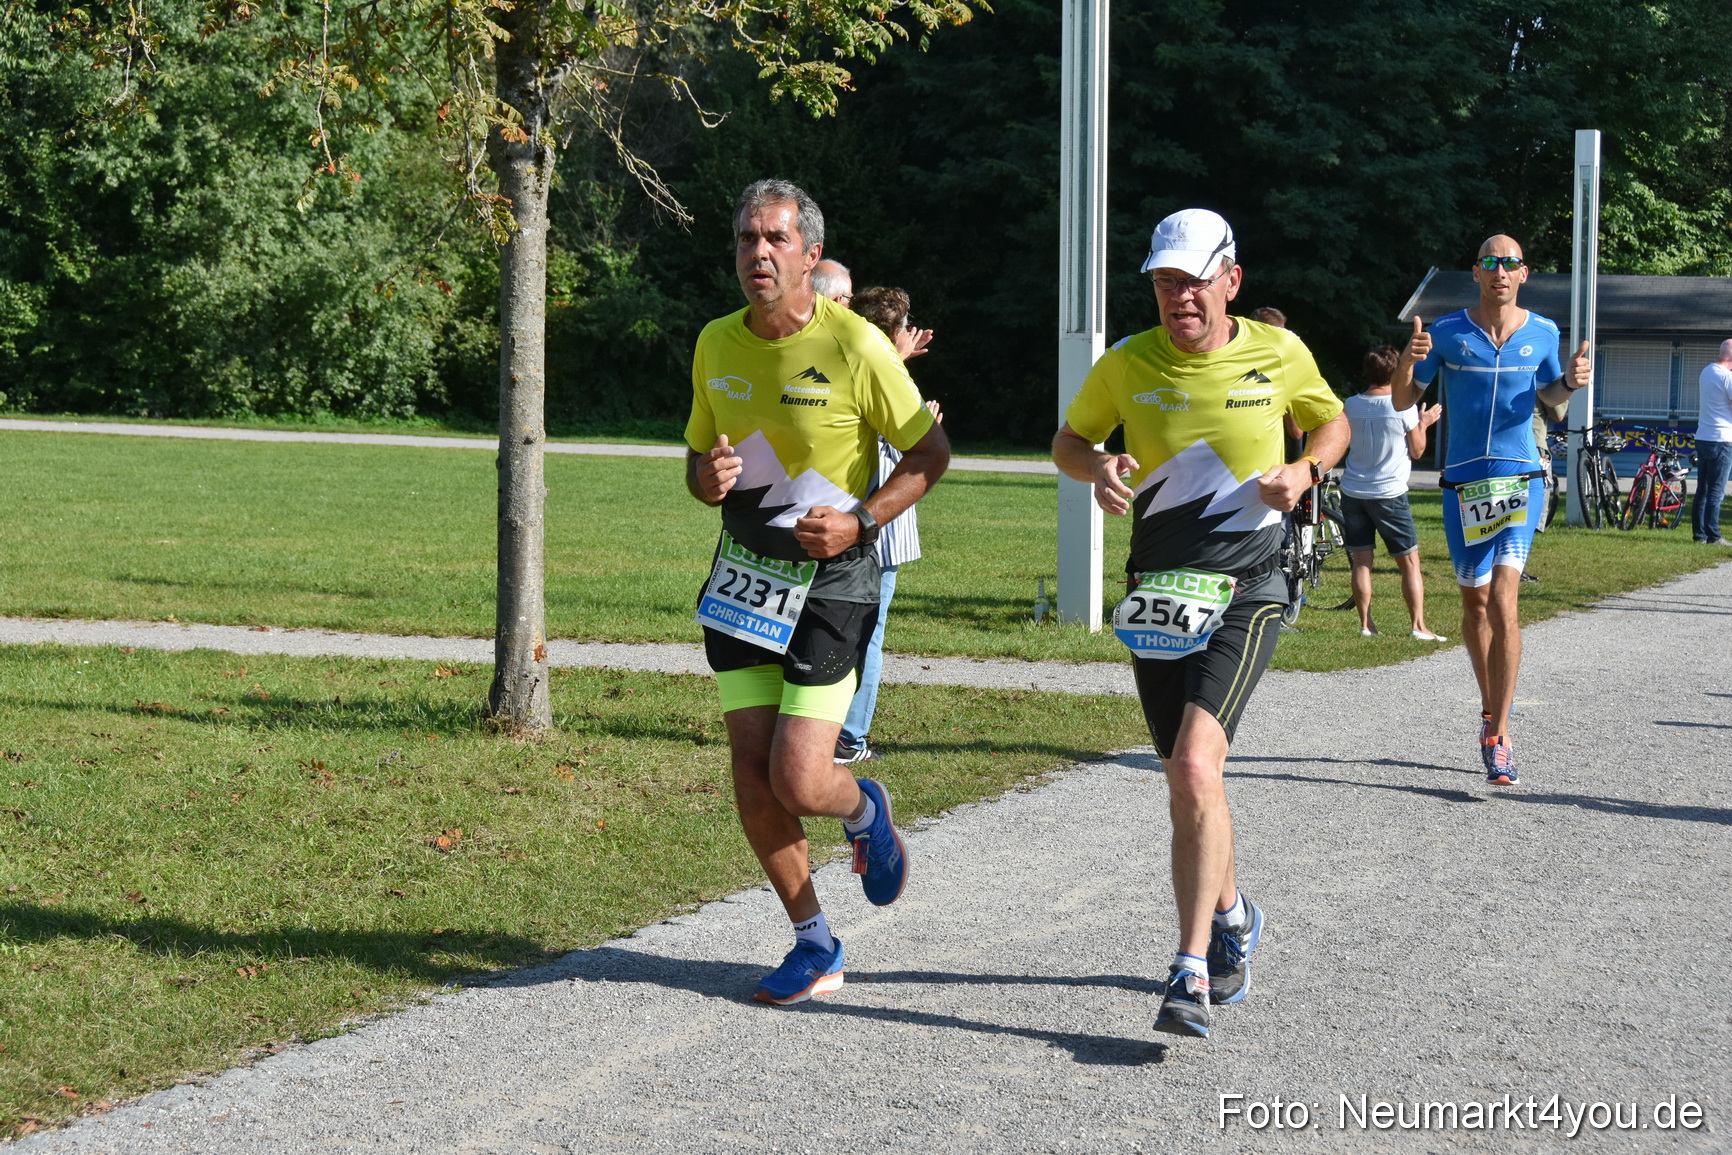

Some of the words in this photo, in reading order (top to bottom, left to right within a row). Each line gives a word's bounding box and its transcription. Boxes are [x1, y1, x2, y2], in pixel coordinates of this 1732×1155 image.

[727, 391, 752, 401] MARX
[784, 384, 831, 395] Kettenbach
[1227, 387, 1273, 397] Kettenbach
[780, 394, 828, 407] Runners
[1159, 403, 1190, 411] MARX
[1225, 397, 1272, 410] Runners
[1464, 480, 1521, 500] BOCK
[1469, 493, 1522, 522] 1216
[1480, 515, 1512, 536] RAINER
[717, 567, 791, 616] 2231
[1139, 572, 1222, 600] BOCK
[707, 602, 782, 639] CHRISTIAN
[1127, 596, 1215, 635] 2547
